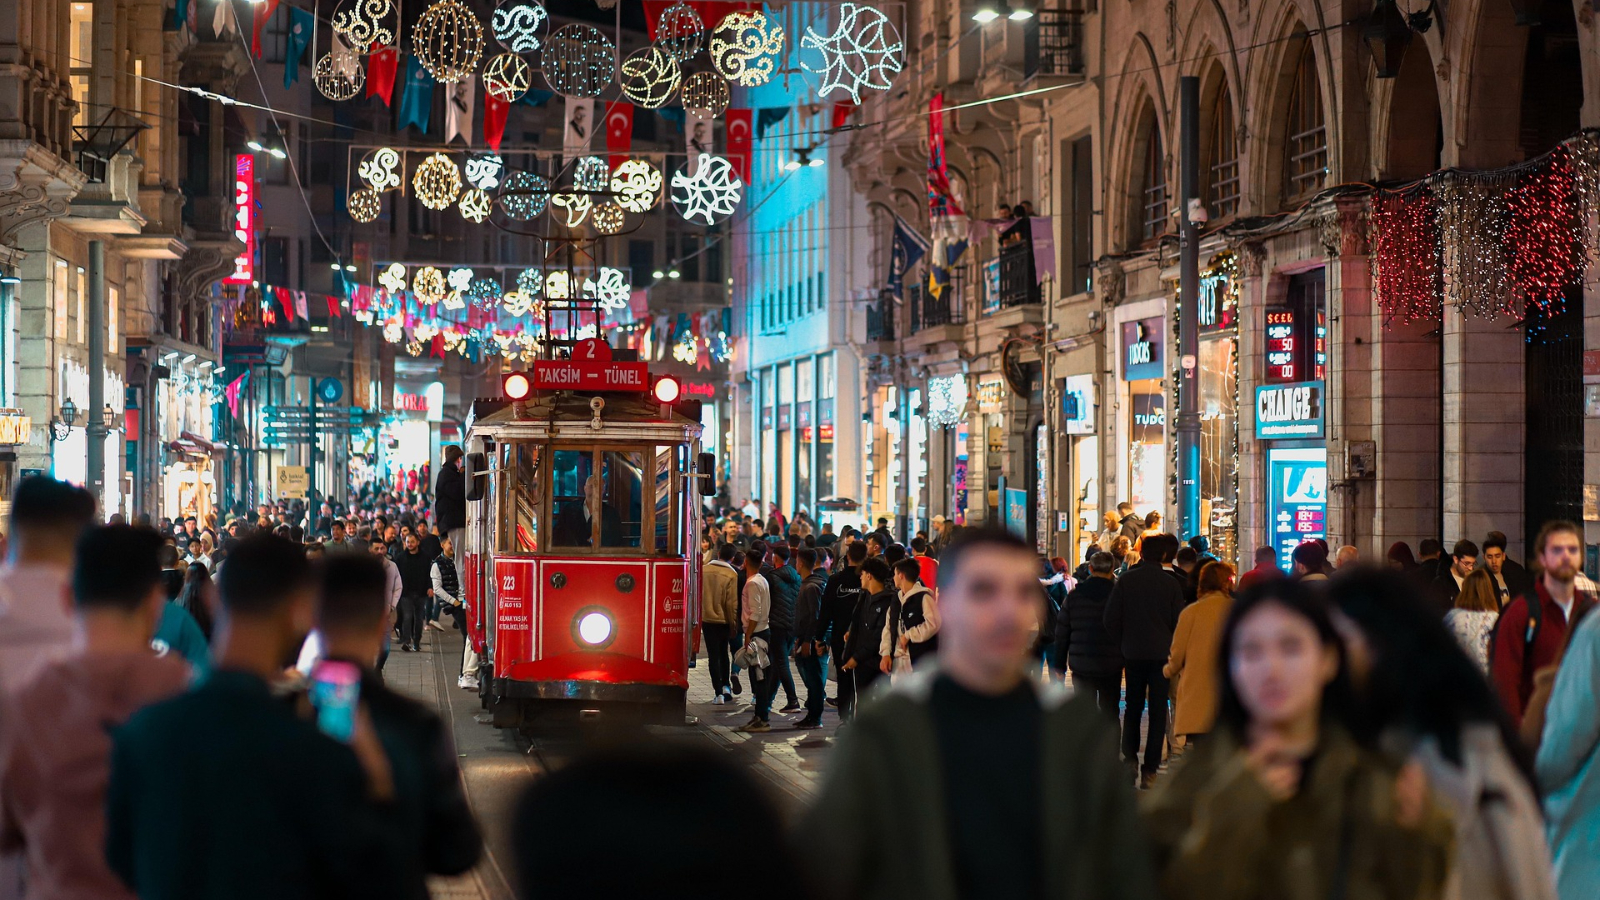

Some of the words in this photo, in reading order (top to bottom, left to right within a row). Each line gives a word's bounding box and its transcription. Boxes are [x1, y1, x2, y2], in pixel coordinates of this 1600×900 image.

[586, 341, 595, 359] 2
[538, 365, 581, 383] TAKSİM
[604, 366, 642, 385] TÜNEL
[396, 393, 430, 411] CORAL
[1258, 387, 1311, 422] CHANGE
[503, 576, 515, 590] 223
[672, 578, 682, 593] 223
